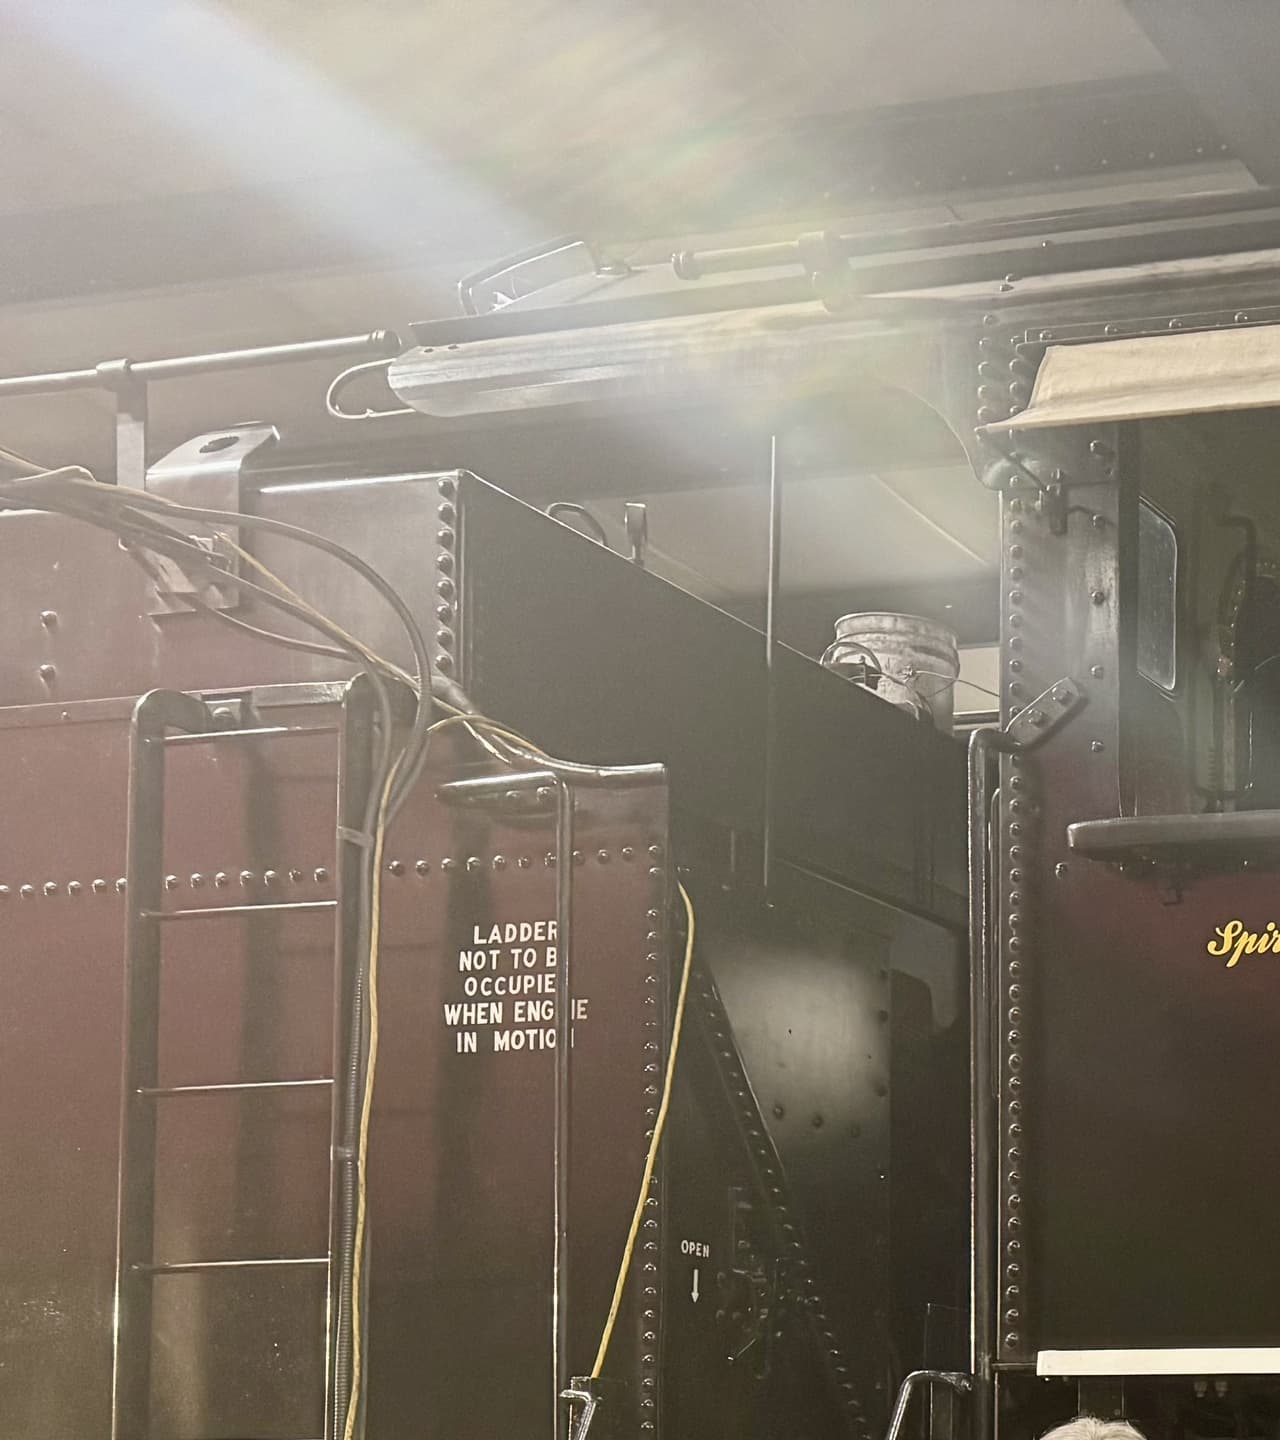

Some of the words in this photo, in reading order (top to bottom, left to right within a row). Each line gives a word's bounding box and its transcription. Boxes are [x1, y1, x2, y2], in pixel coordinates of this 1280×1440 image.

[459, 950, 500, 971] NOT
[511, 947, 537, 969] TO
[546, 946, 558, 968] B
[464, 973, 557, 997] OCCUPIE
[444, 1002, 503, 1026] WHEN
[456, 1031, 478, 1053] IN
[681, 1239, 710, 1258] OPEN
